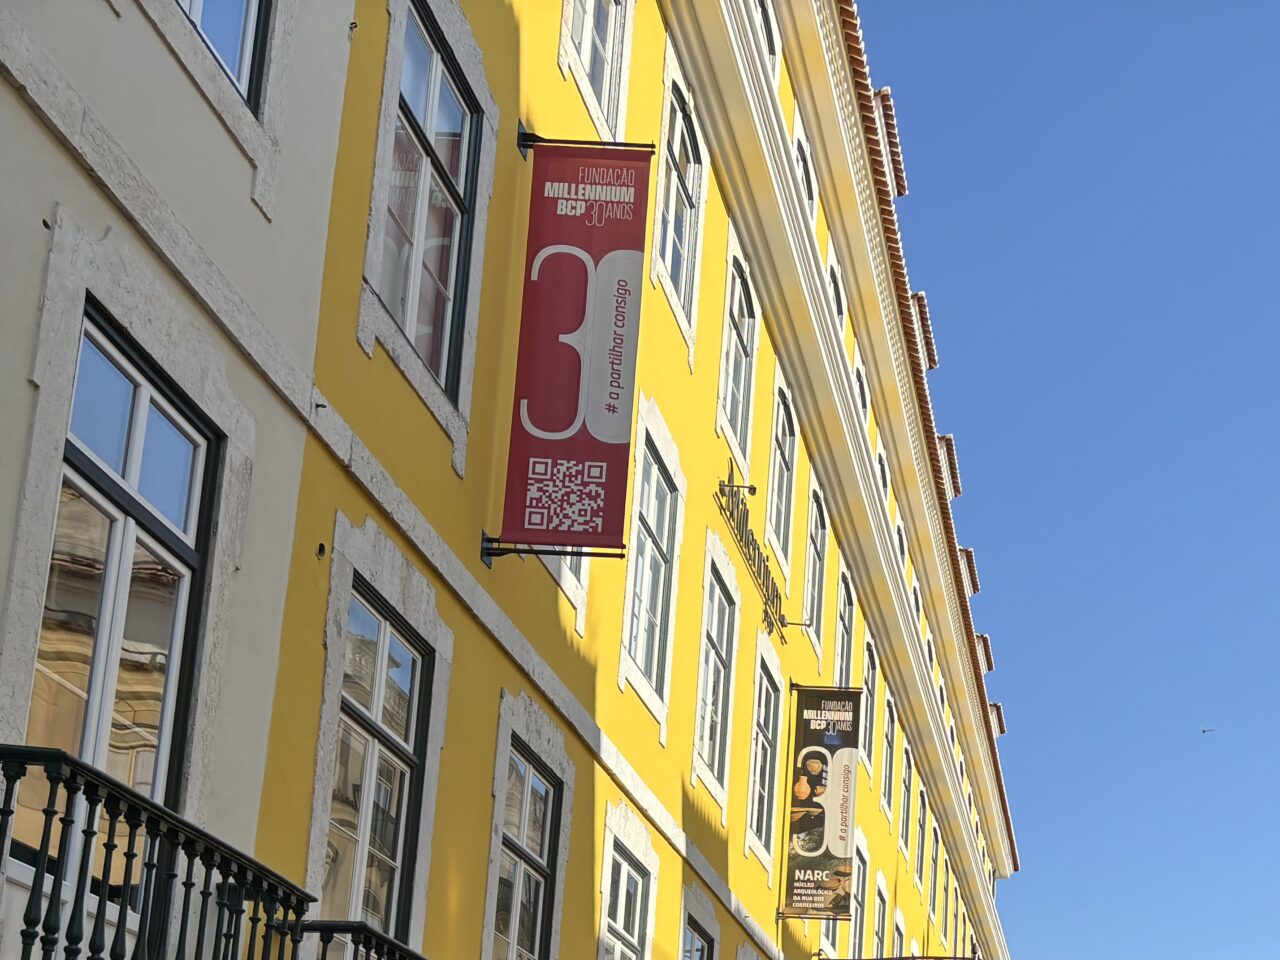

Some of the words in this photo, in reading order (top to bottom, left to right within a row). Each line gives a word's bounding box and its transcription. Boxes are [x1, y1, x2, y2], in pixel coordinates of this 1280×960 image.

[579, 166, 636, 187] FUNDAÇÃO
[544, 181, 636, 203] MILLENNIUM
[556, 200, 586, 216] BCP
[605, 203, 634, 220] ANOS
[613, 279, 631, 329] consigo
[608, 330, 625, 389] partilhar
[803, 709, 853, 721] MILLENNIUM
[821, 700, 853, 712] FUNDAÇÃO
[810, 719, 827, 730] BCP
[843, 764, 851, 793] consigo
[840, 795, 849, 827] partilhar
[794, 869, 830, 881] NARC
